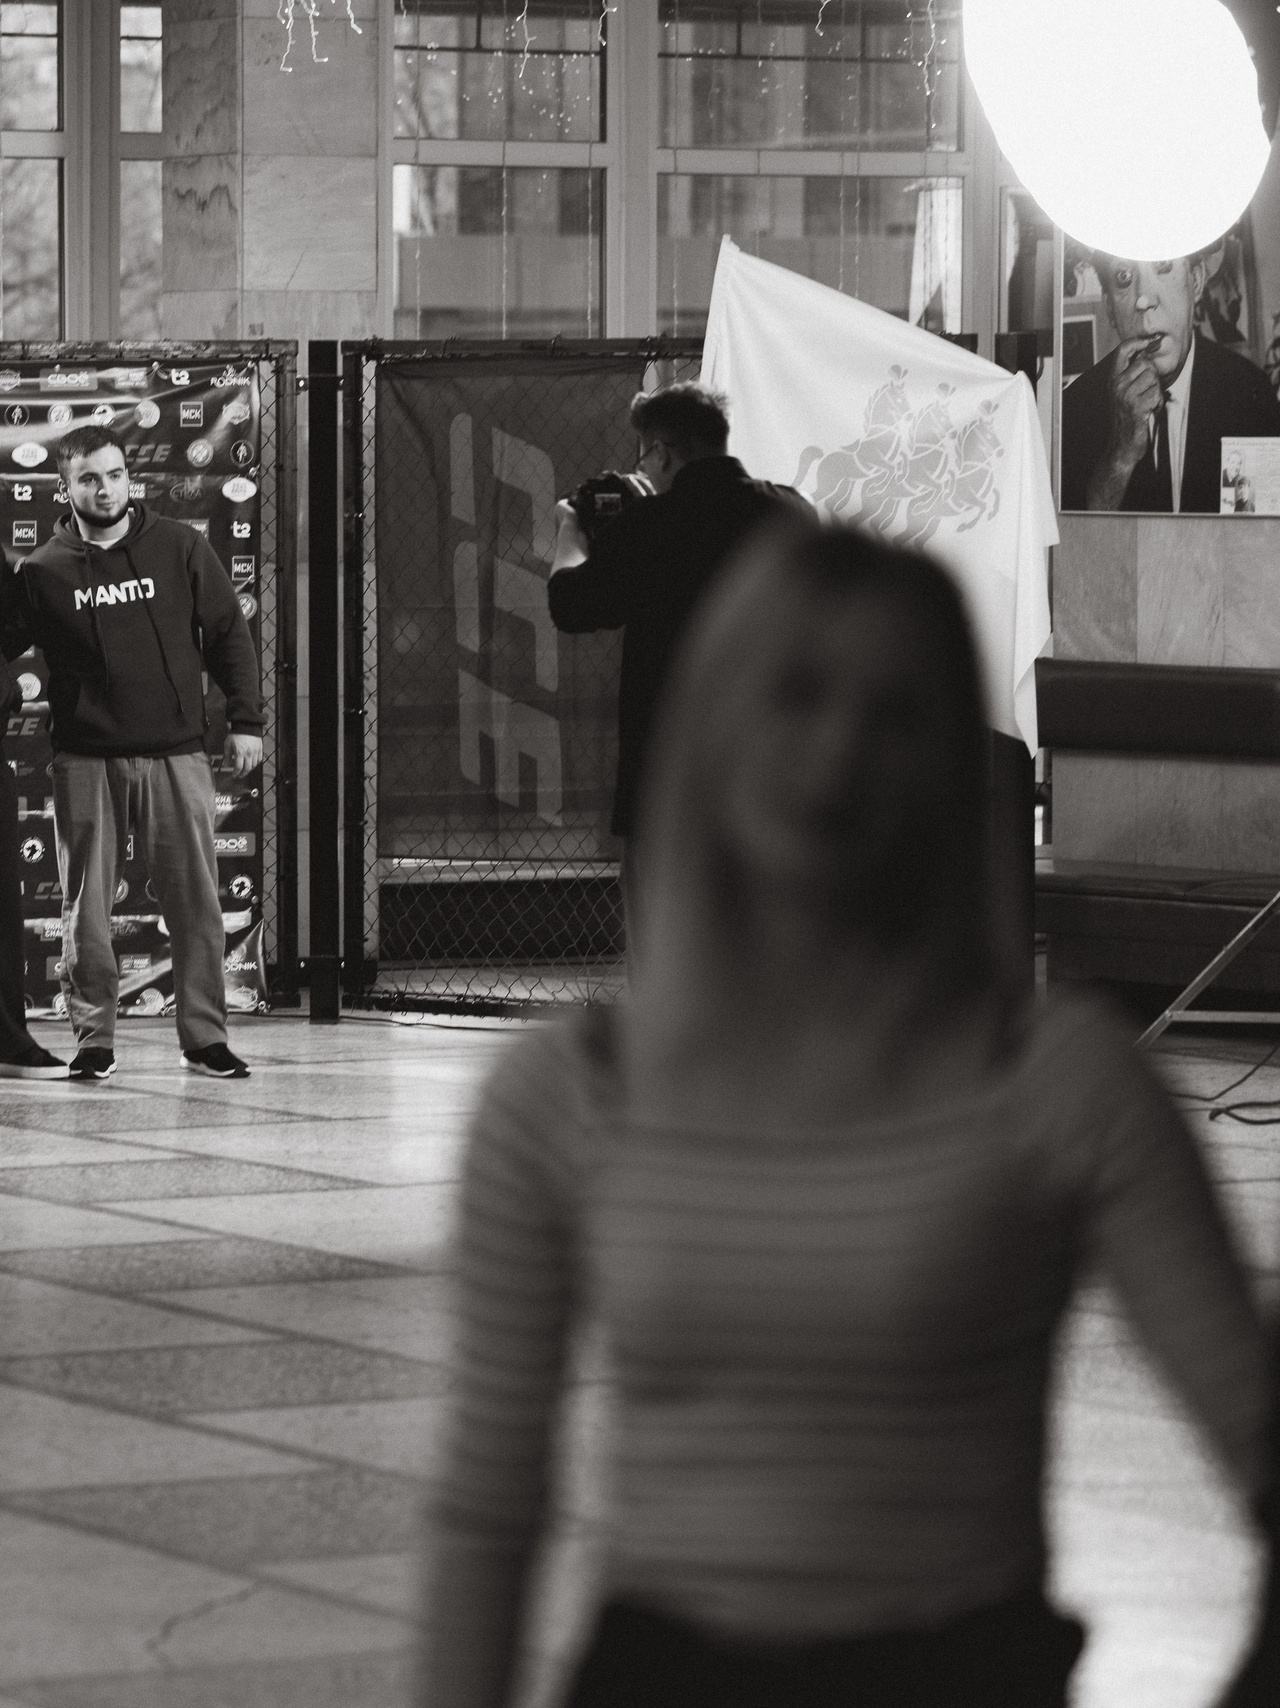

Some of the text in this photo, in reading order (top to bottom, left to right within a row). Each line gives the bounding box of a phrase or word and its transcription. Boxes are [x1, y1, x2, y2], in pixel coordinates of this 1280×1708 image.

[210, 377, 252, 388] RODNIK
[74, 578, 155, 610] MANTO
[6, 718, 40, 735] CE
